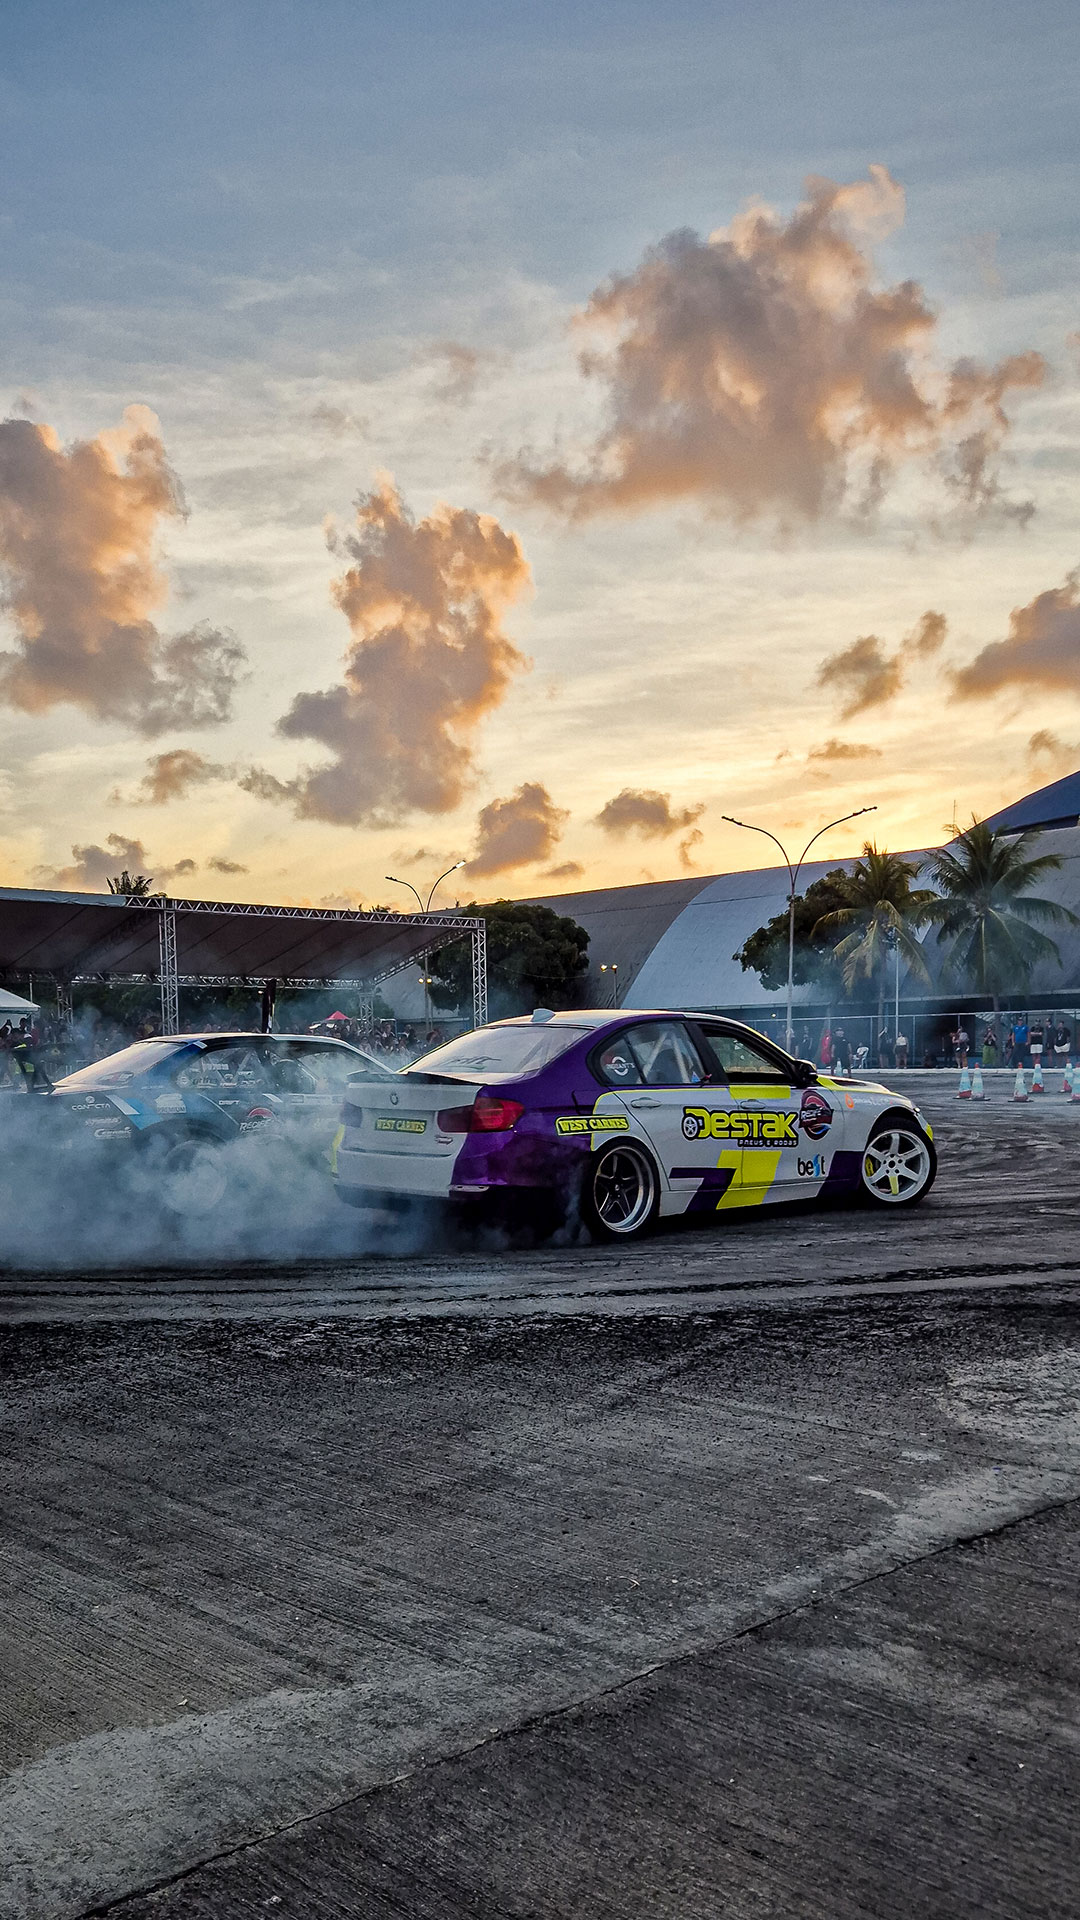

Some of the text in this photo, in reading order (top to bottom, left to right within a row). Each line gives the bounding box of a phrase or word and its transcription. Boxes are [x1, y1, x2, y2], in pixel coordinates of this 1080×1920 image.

[156, 1106, 186, 1114] PREMIUM
[376, 1118, 426, 1132] WEST CARNES
[558, 1118, 628, 1132] WEST CARNES
[797, 1153, 826, 1177] best
